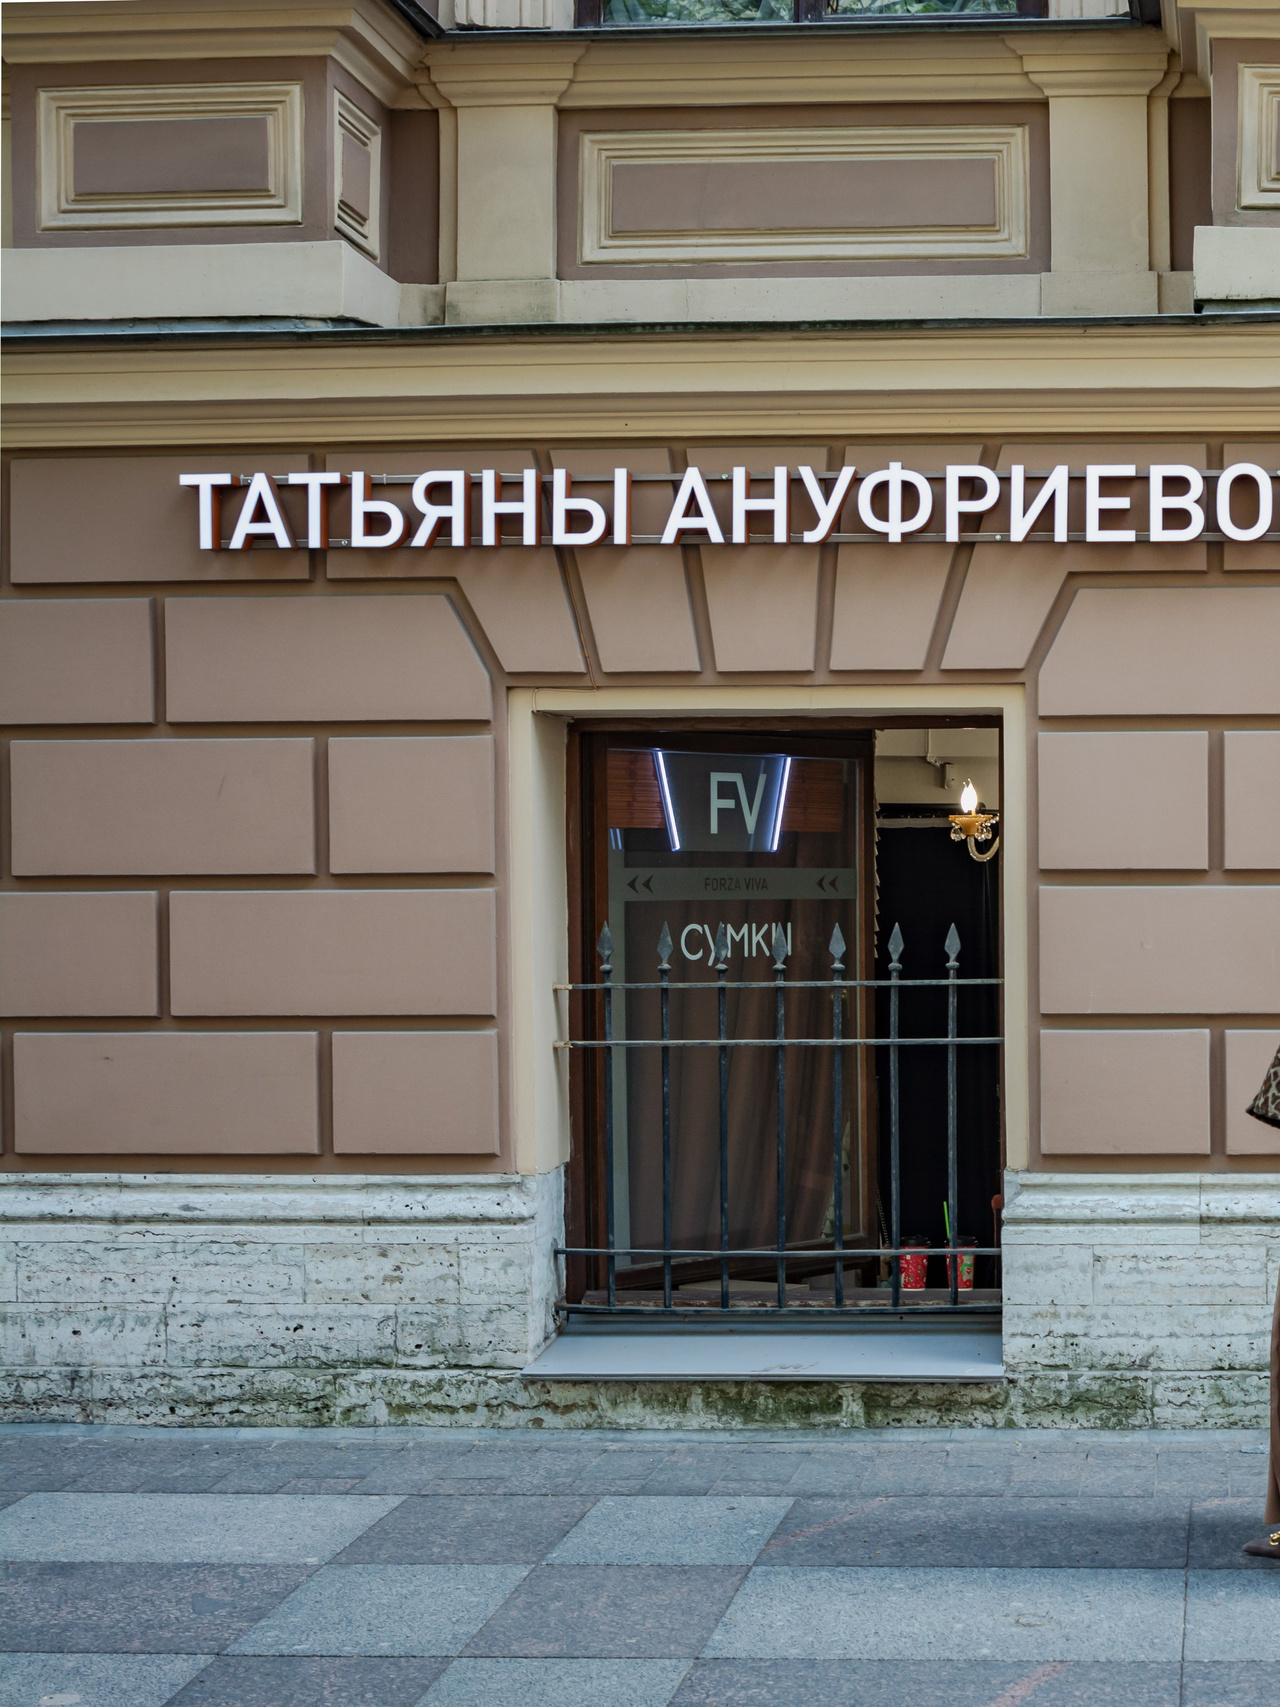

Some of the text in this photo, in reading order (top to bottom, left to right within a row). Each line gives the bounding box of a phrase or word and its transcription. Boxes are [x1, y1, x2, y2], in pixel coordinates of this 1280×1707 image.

[179, 468, 628, 549] ТАТЬЯНЫ
[710, 771, 767, 835] FV
[704, 877, 769, 892] FORZA VIVA
